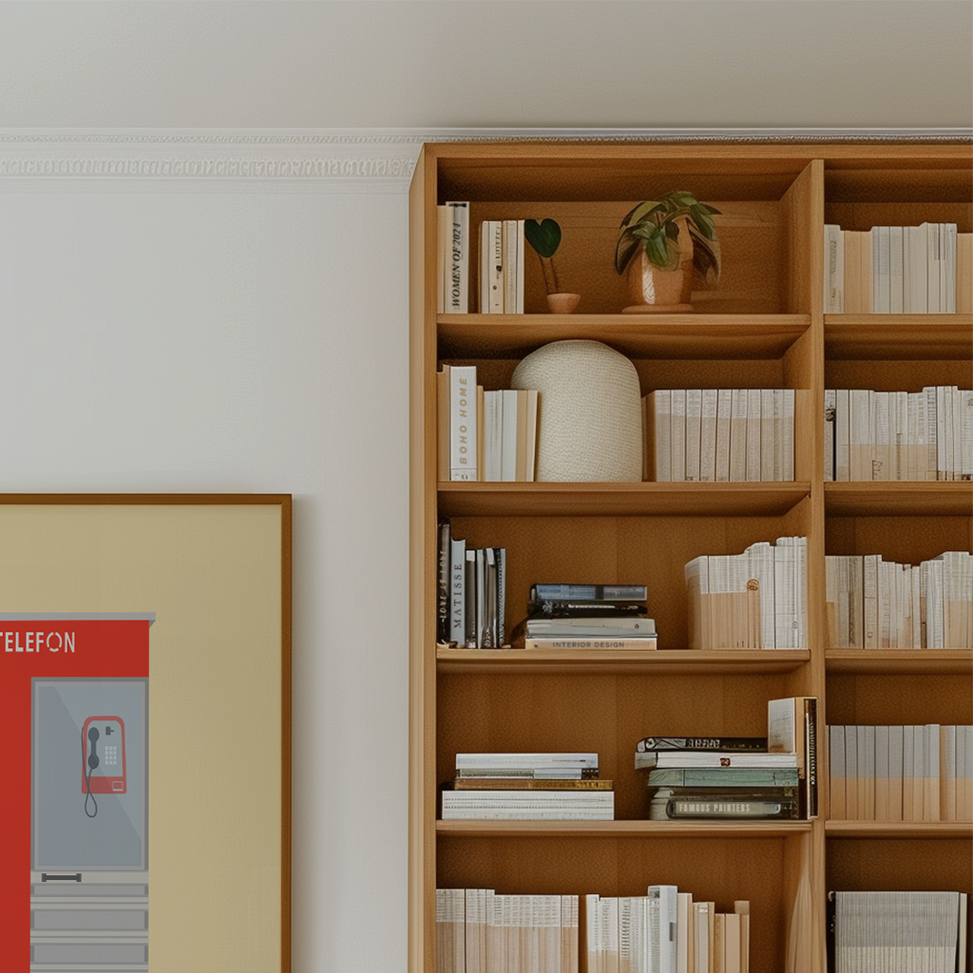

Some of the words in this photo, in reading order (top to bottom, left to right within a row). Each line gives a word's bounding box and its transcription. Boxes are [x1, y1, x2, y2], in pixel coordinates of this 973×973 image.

[453, 245, 461, 262] OF
[452, 264, 461, 307] WOMEN
[459, 378, 467, 418] HOME
[459, 425, 467, 465] BOHO
[453, 563, 462, 629] MATISSE
[679, 803, 710, 812] FAMOUS
[713, 803, 750, 812] PAINTERS
